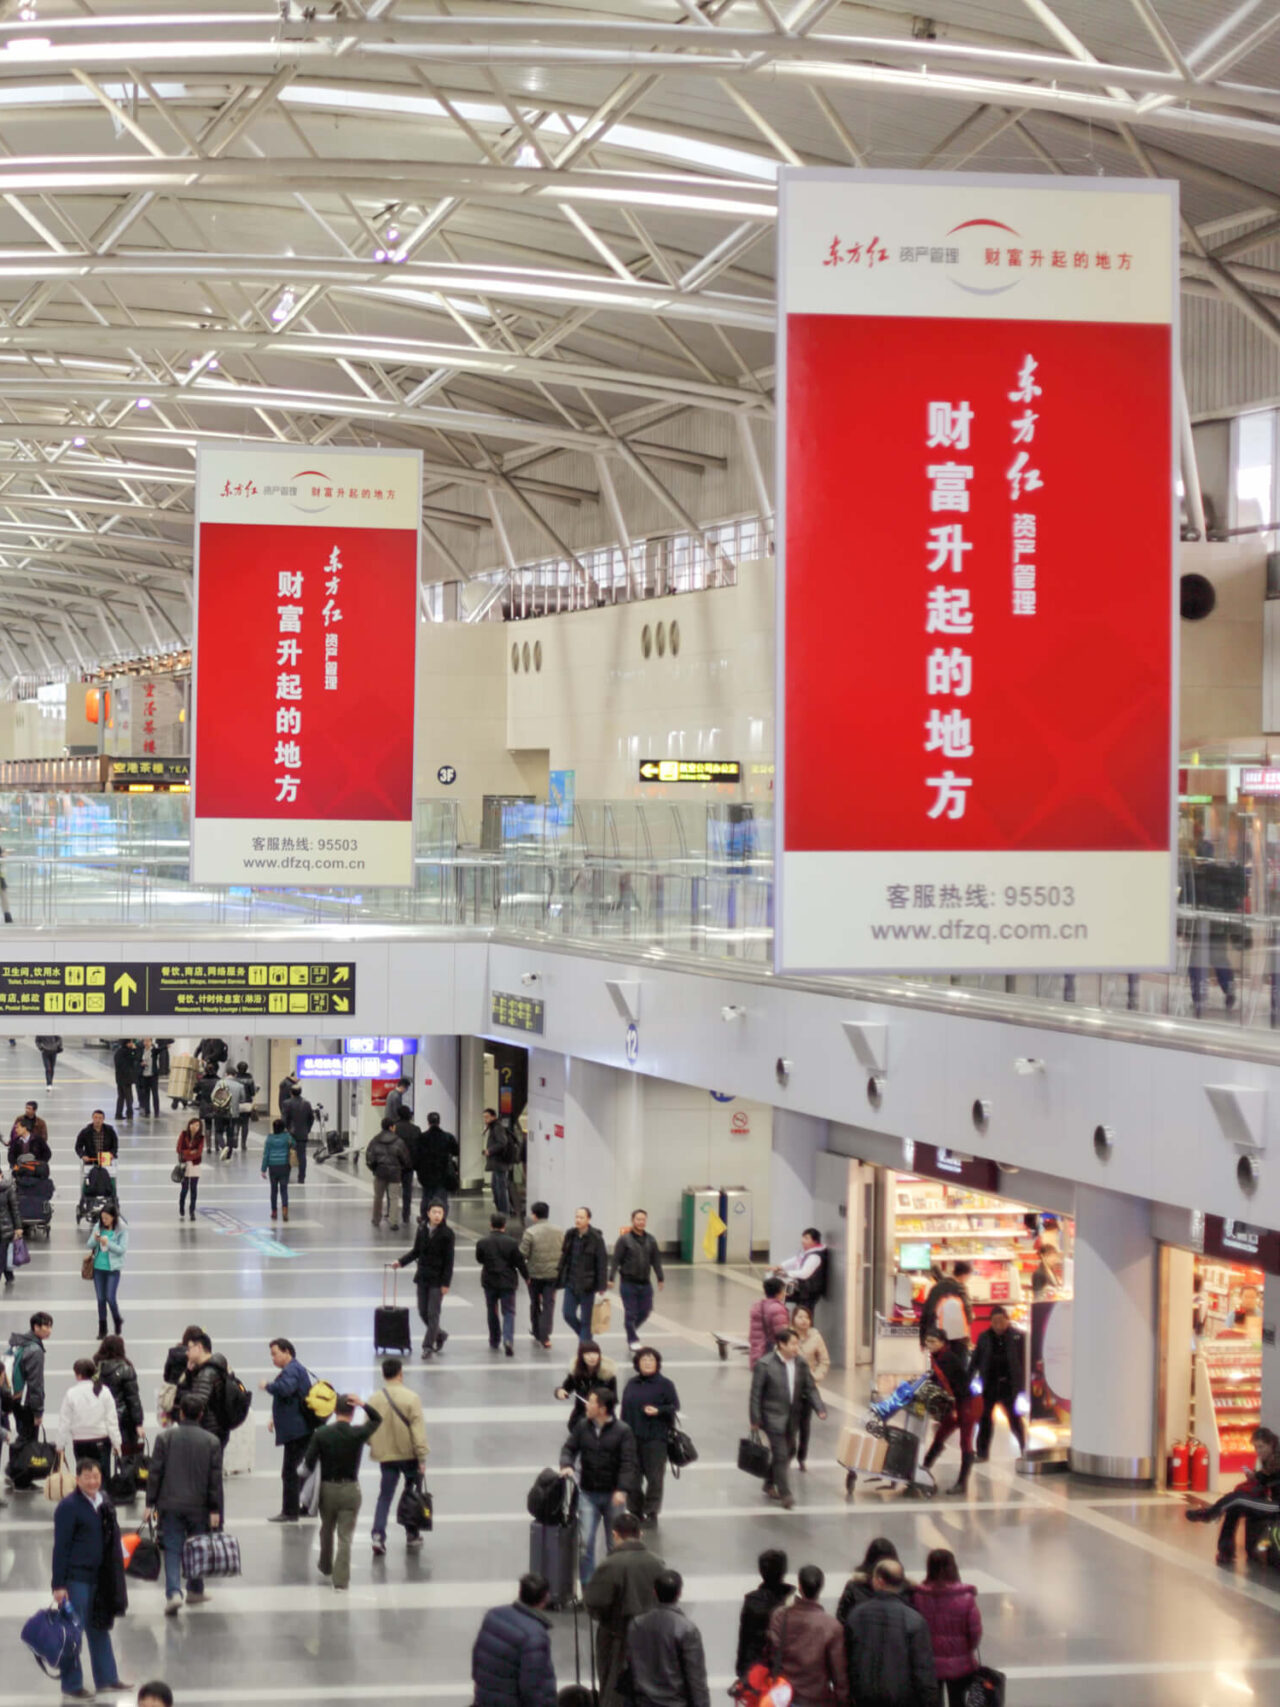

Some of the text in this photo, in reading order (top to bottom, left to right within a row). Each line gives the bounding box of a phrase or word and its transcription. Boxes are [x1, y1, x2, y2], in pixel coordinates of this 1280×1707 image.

[822, 234, 1133, 271] 东方红 资产管理 财富升起的地方
[311, 486, 396, 500] 财富升起的地方
[1006, 353, 1044, 615] 东方红 资产管理
[924, 400, 975, 820] 财富升起的地方
[324, 633, 338, 690] 资产管理
[274, 571, 304, 803] 财富升起的地方
[169, 765, 189, 774] TEA
[440, 768, 454, 782] 3F
[252, 837, 358, 851] 客服热线: 95503
[243, 856, 365, 871] www.dfzq.com.cn
[886, 884, 1075, 909] 客服热线: 95503
[871, 920, 1088, 943] www.dfzq.com.cn
[627, 1029, 637, 1059] 12
